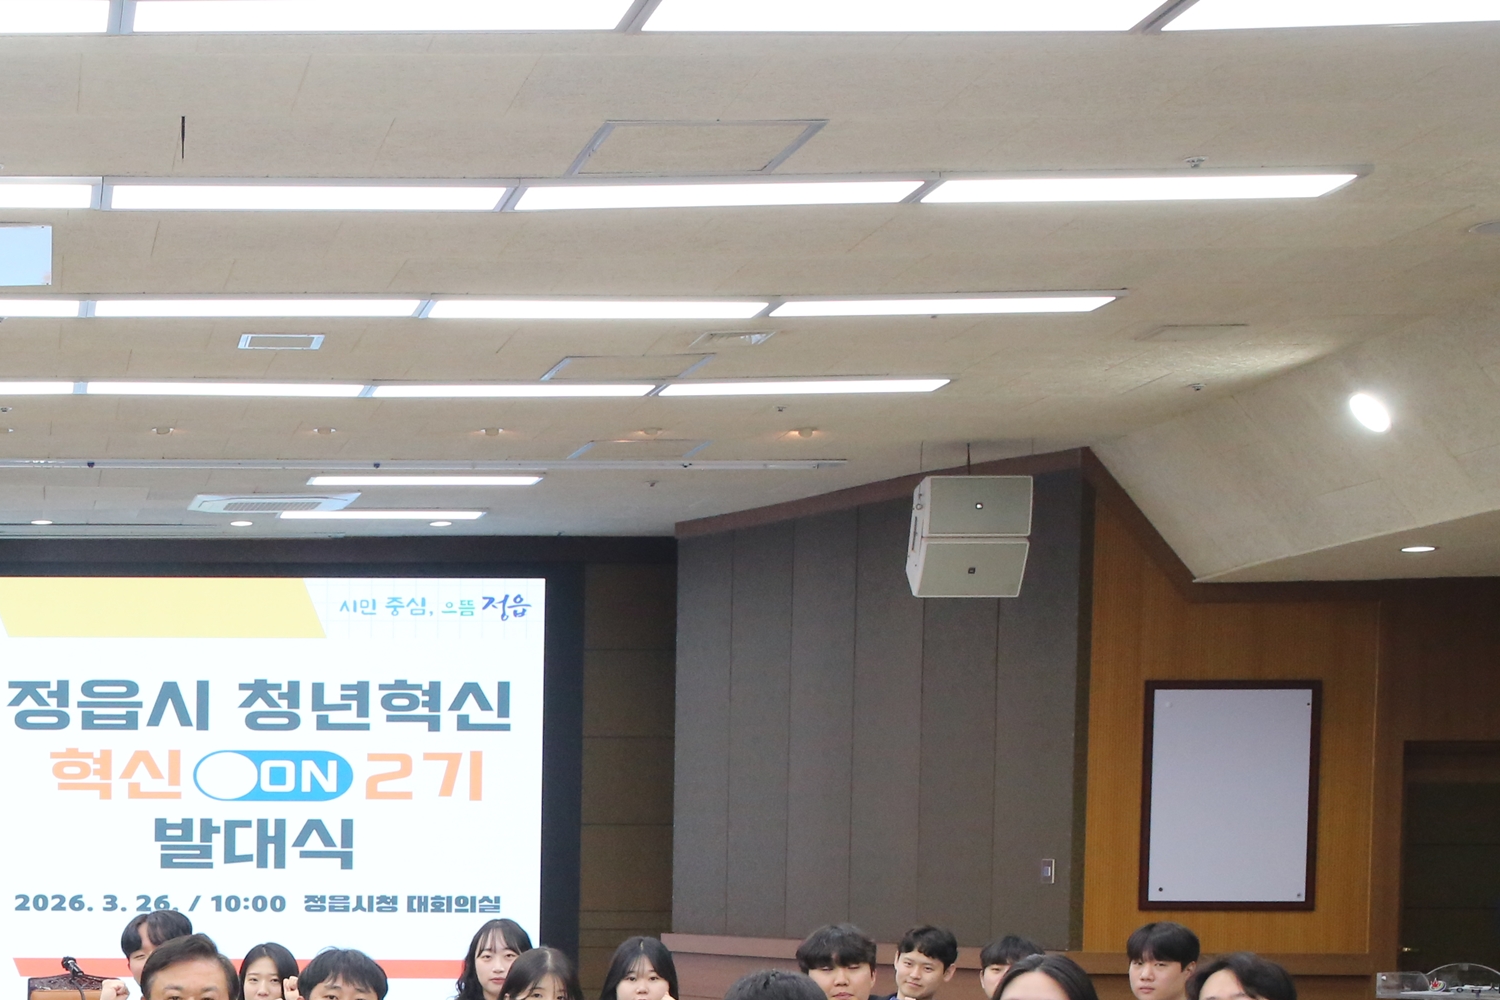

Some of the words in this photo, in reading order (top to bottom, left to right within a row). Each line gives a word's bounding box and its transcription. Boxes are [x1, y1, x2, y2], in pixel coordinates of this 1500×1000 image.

[339, 598, 377, 616] 시민
[385, 596, 434, 617] 중심,
[440, 599, 476, 617] 으뜸
[481, 593, 532, 622] 정읍
[6, 678, 210, 731] 정읍시
[237, 678, 512, 733] 청년혁신
[49, 747, 183, 800] 혁신
[259, 759, 338, 793] ON
[364, 749, 483, 801] 2기
[153, 817, 354, 870] 발대식
[14, 894, 94, 912] 2026.
[102, 894, 128, 912] 3.
[136, 894, 179, 913] 26.
[211, 895, 287, 913] 10:00
[303, 894, 399, 913] 정읍시청
[406, 895, 501, 913] 대회의실
